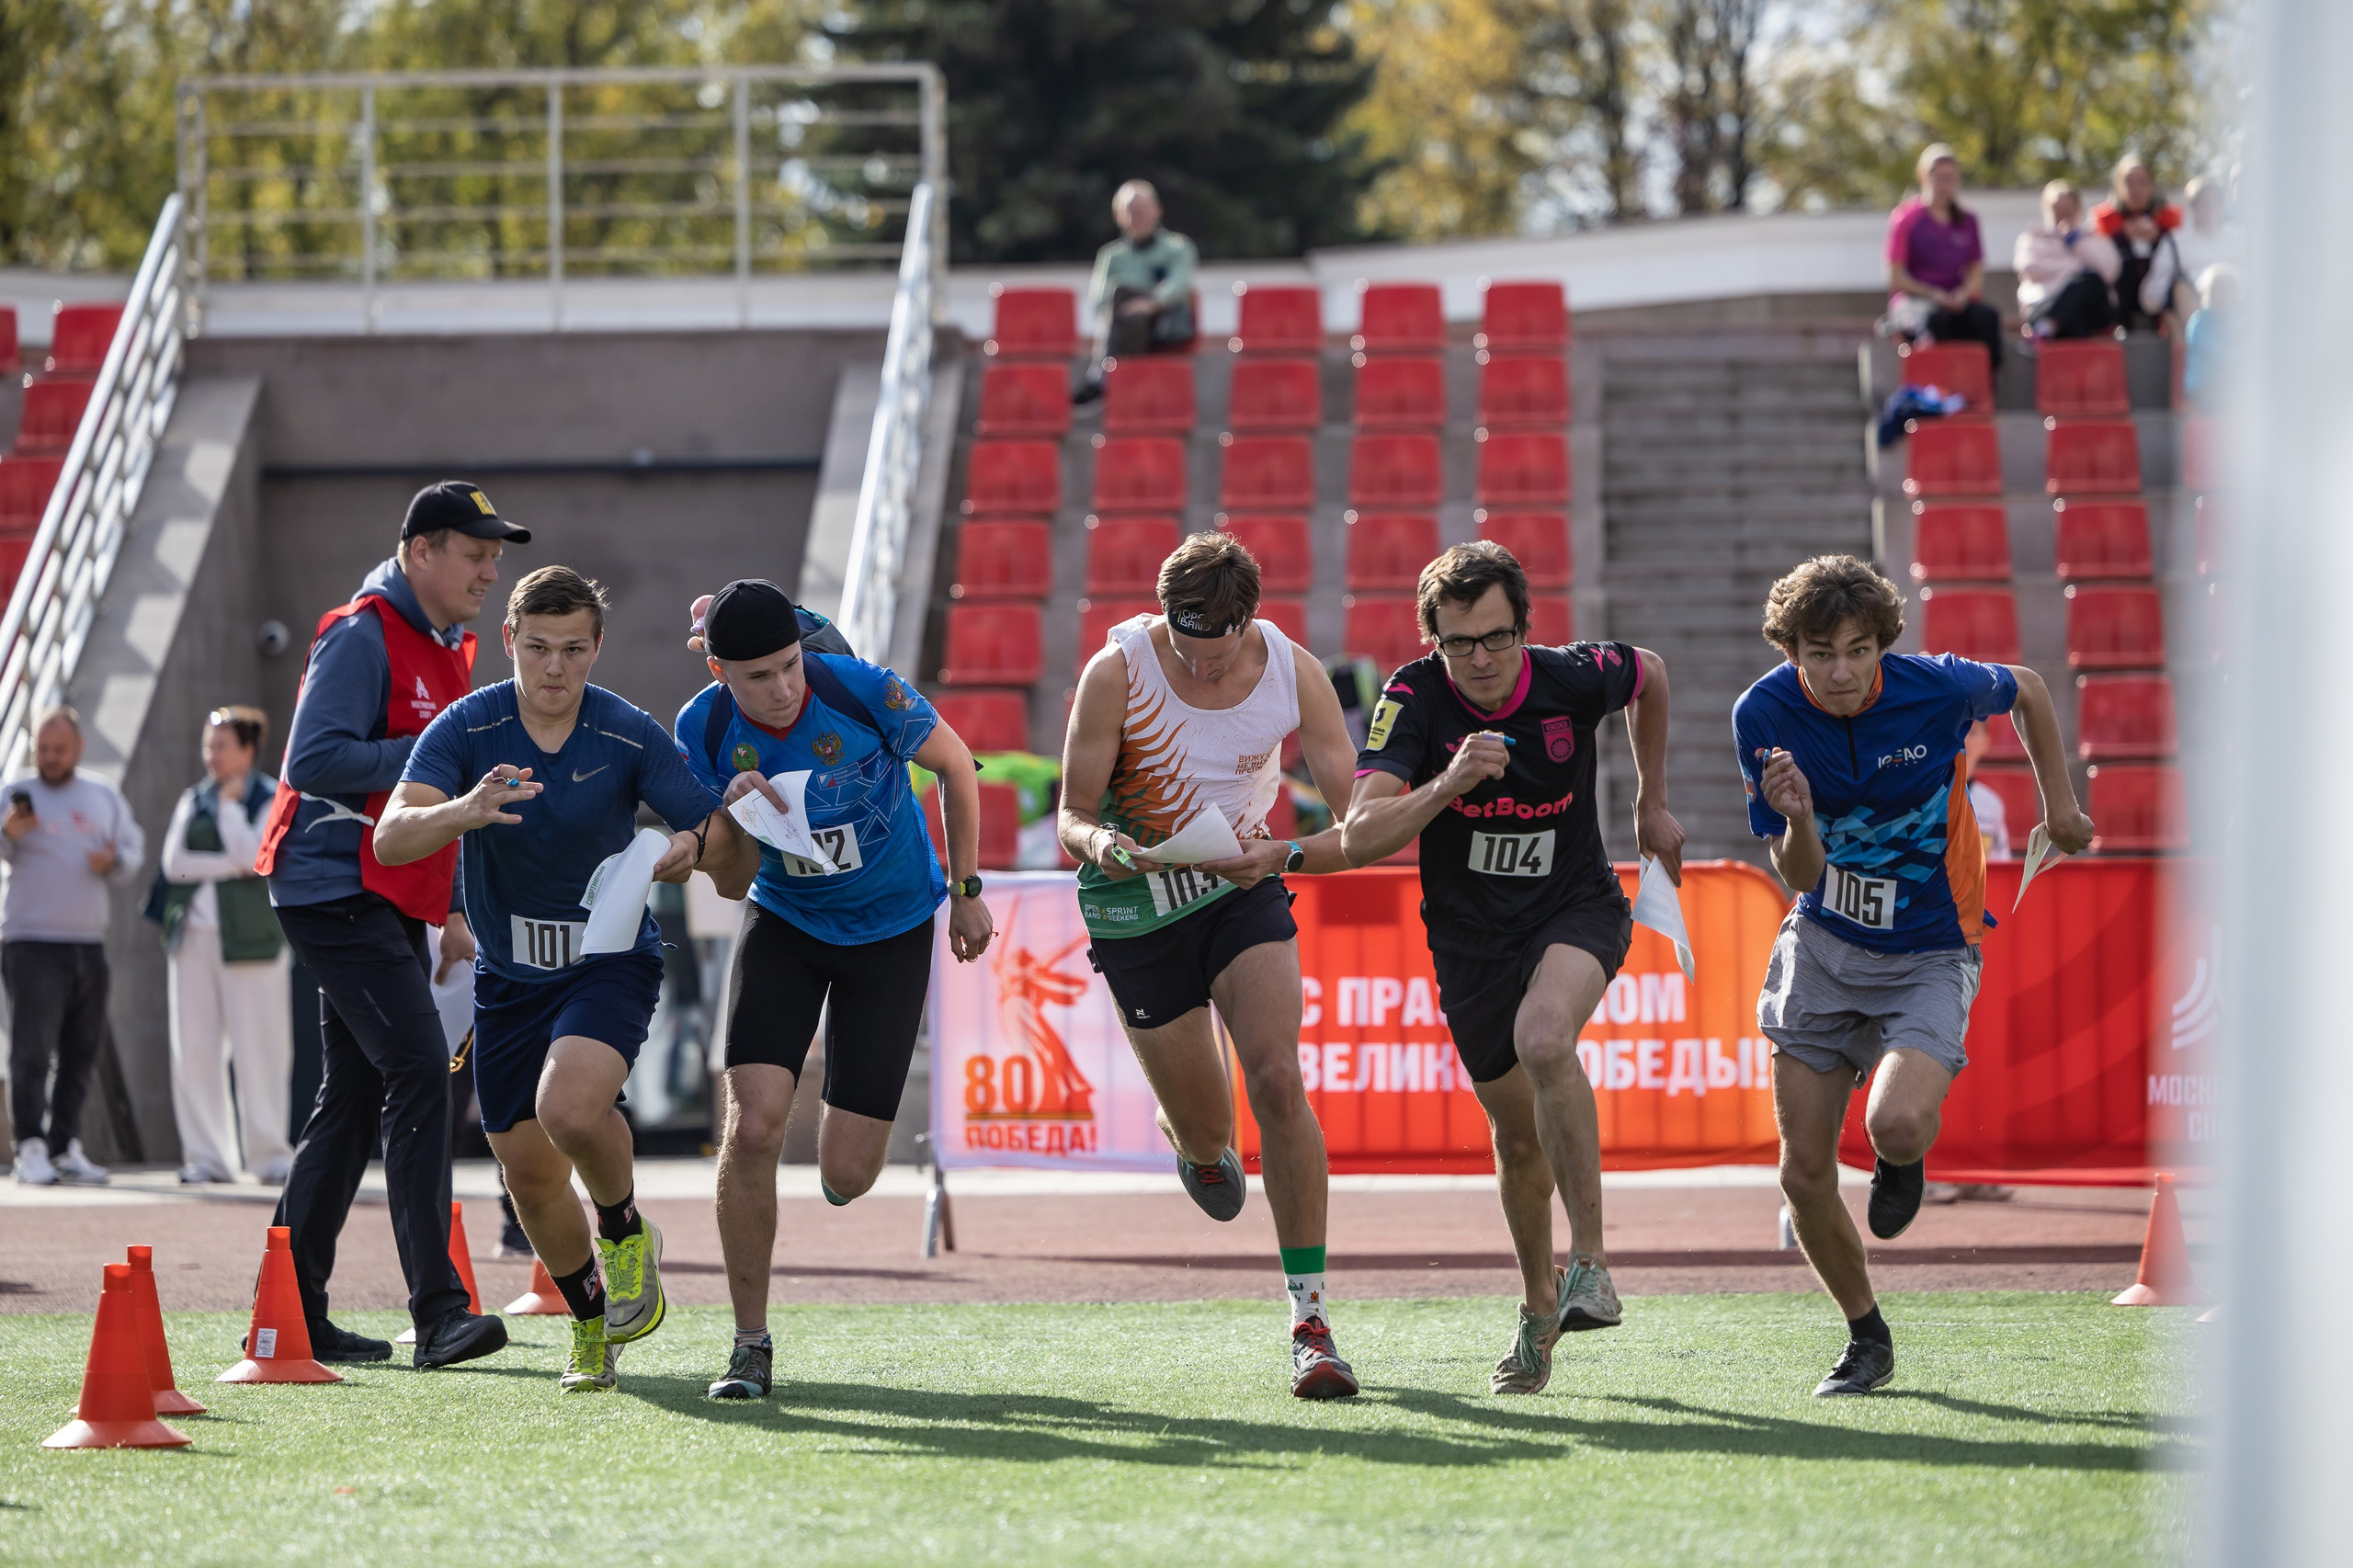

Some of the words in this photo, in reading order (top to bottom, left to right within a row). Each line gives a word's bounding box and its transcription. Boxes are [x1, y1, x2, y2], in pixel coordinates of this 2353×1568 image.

[1447, 791, 1574, 820] BetBoom
[1483, 835, 1542, 874] 104
[1085, 911, 1101, 919] BAND
[1106, 906, 1139, 915] SPRINT
[1835, 868, 1885, 926] 105
[1107, 914, 1139, 922] WEEKEND
[524, 921, 571, 968] 101
[1301, 976, 1324, 1028] С
[965, 1054, 1033, 1115] 80
[1575, 1037, 1770, 1096] ОБЕДЫ!
[966, 1124, 1098, 1156] ПОБЕДА!
